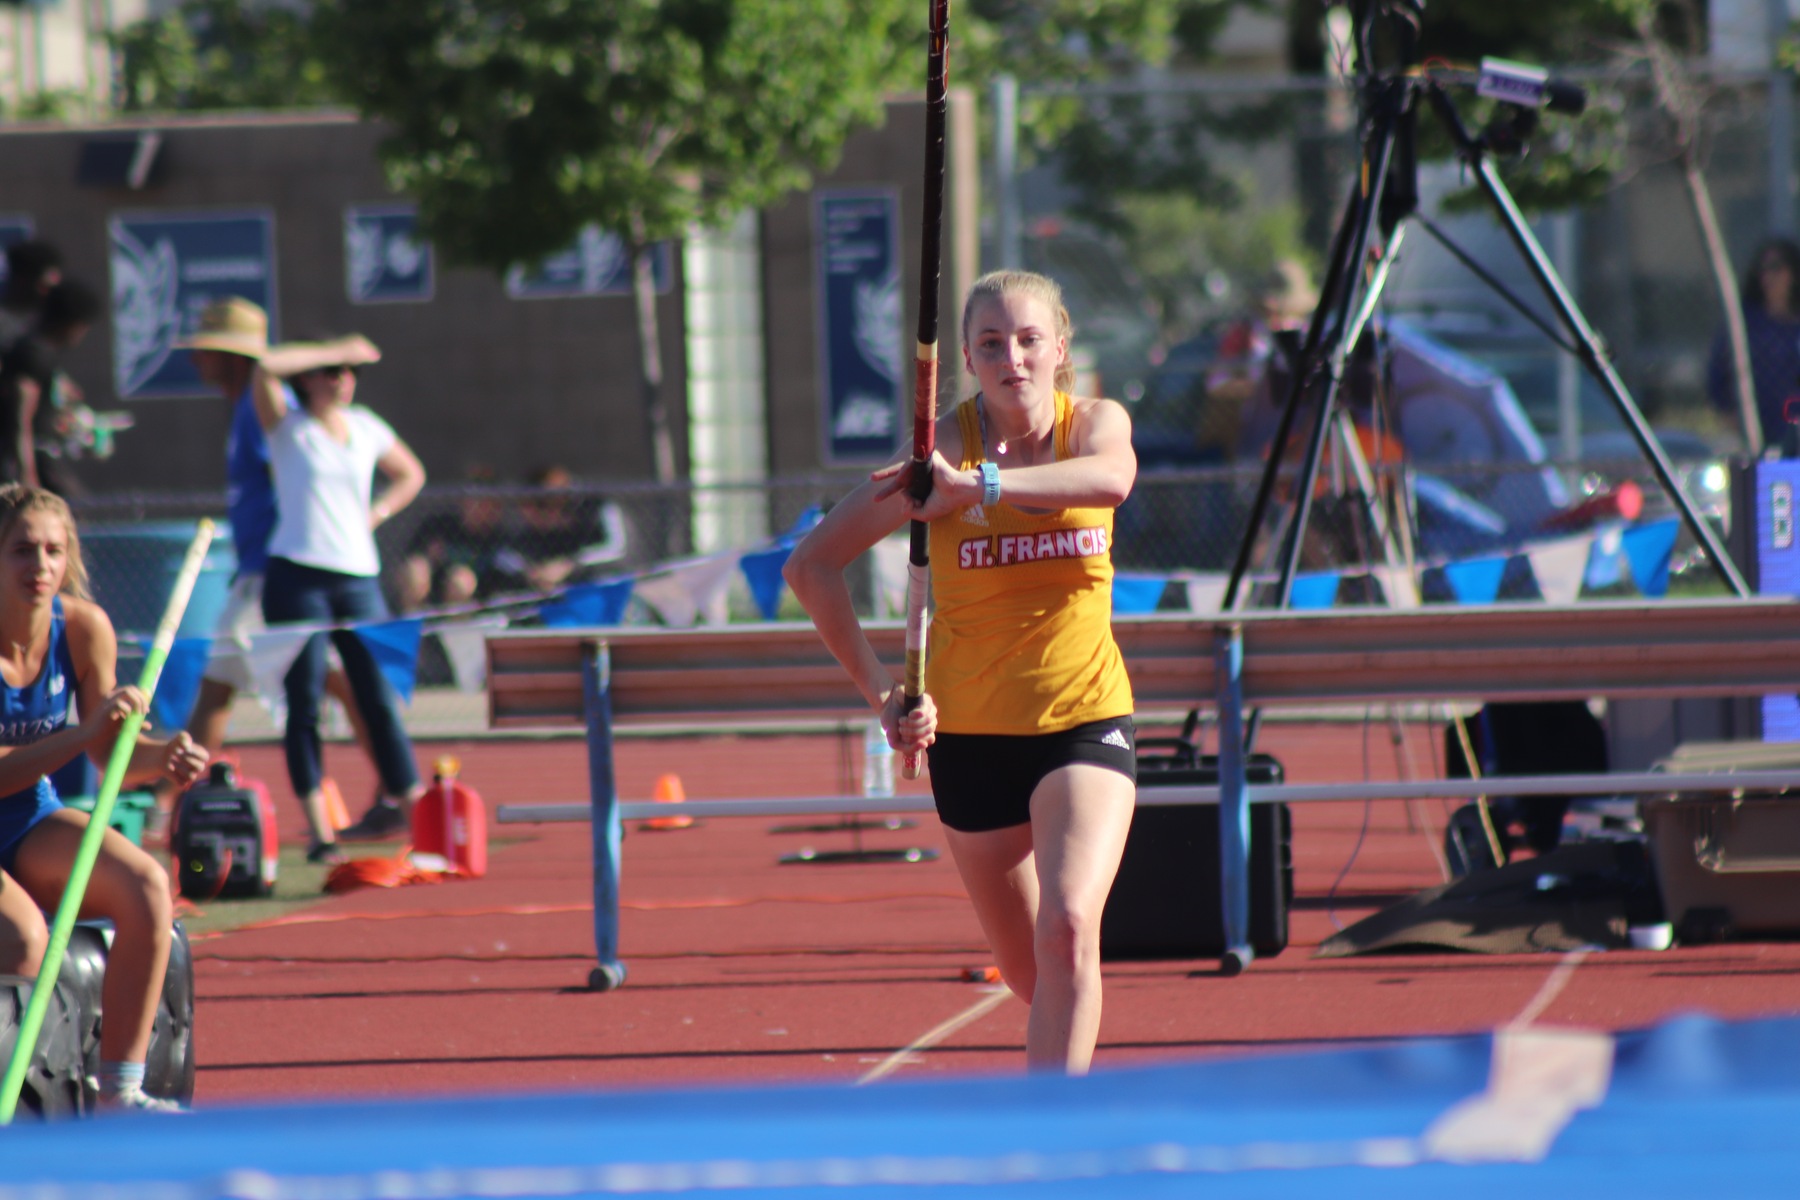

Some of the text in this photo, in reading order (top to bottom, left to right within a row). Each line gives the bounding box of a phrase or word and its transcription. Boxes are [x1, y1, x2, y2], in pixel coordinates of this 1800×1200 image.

[960, 514, 990, 528] adidas
[959, 525, 1107, 570] ST. FRANCIS
[1101, 737, 1130, 751] adidas
